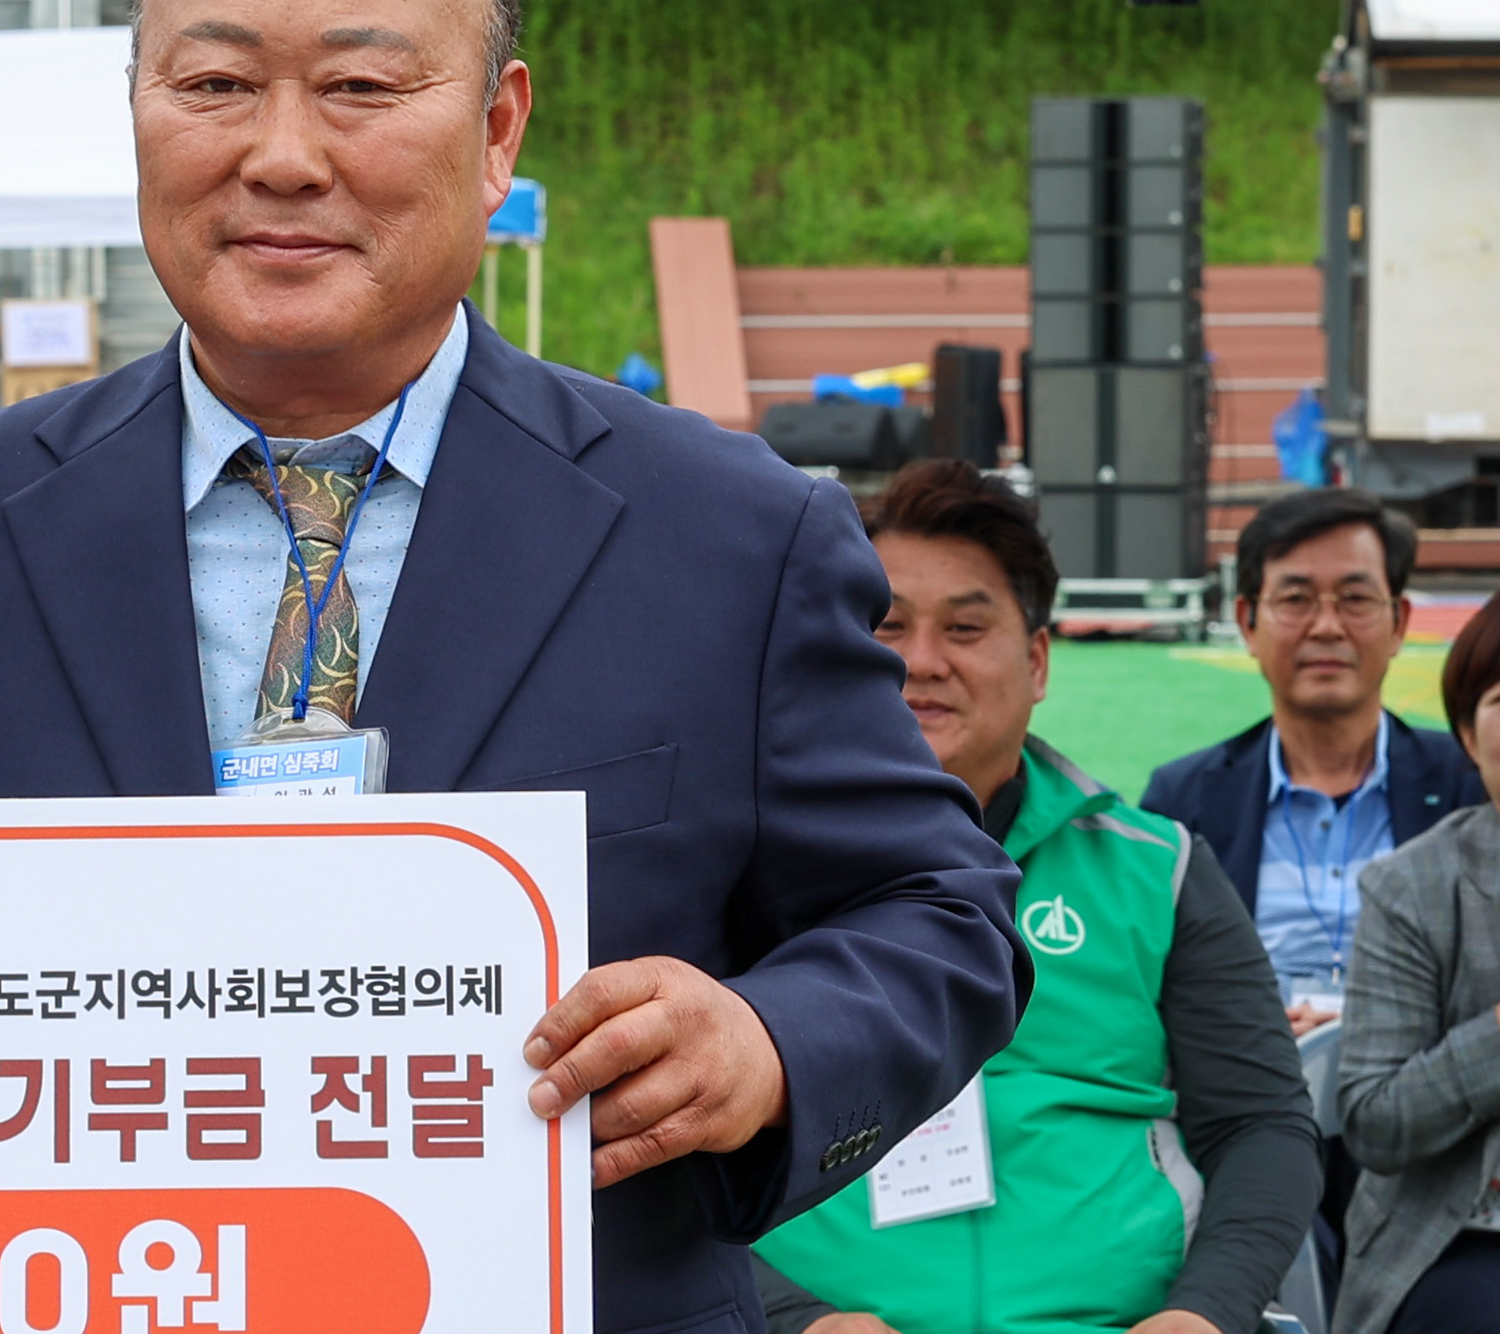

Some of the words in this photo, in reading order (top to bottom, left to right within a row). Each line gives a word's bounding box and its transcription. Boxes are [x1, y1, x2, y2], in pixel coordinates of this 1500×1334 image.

[221, 754, 278, 782] 군내면
[283, 748, 340, 775] 심죽회
[310, 1054, 496, 1162] 전달
